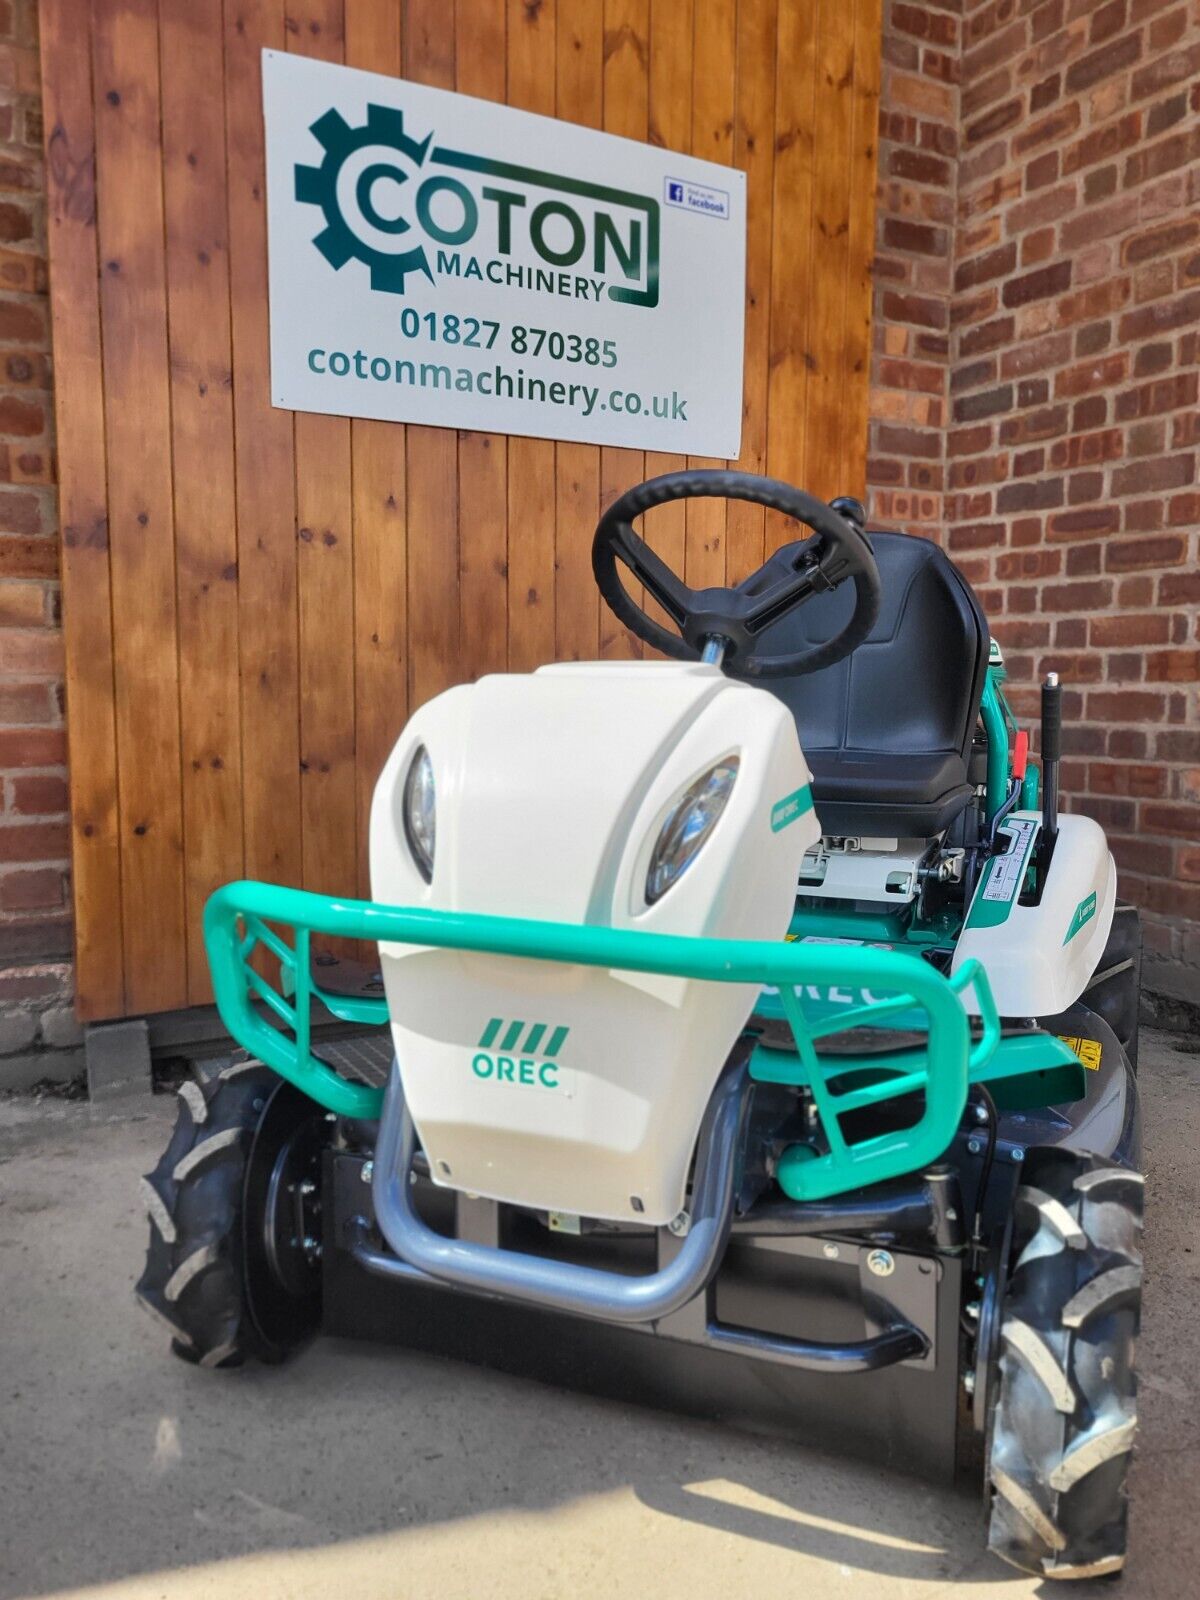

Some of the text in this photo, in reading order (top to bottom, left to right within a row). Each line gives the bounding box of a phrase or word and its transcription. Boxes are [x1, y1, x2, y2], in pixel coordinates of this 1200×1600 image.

[355, 163, 641, 281] COTON
[688, 195, 725, 213] facebook
[437, 250, 606, 302] MACHINERY
[401, 307, 618, 368] 01827 870385
[307, 348, 688, 421] cotonmachinery.co.uk
[472, 1054, 558, 1087] OREC
